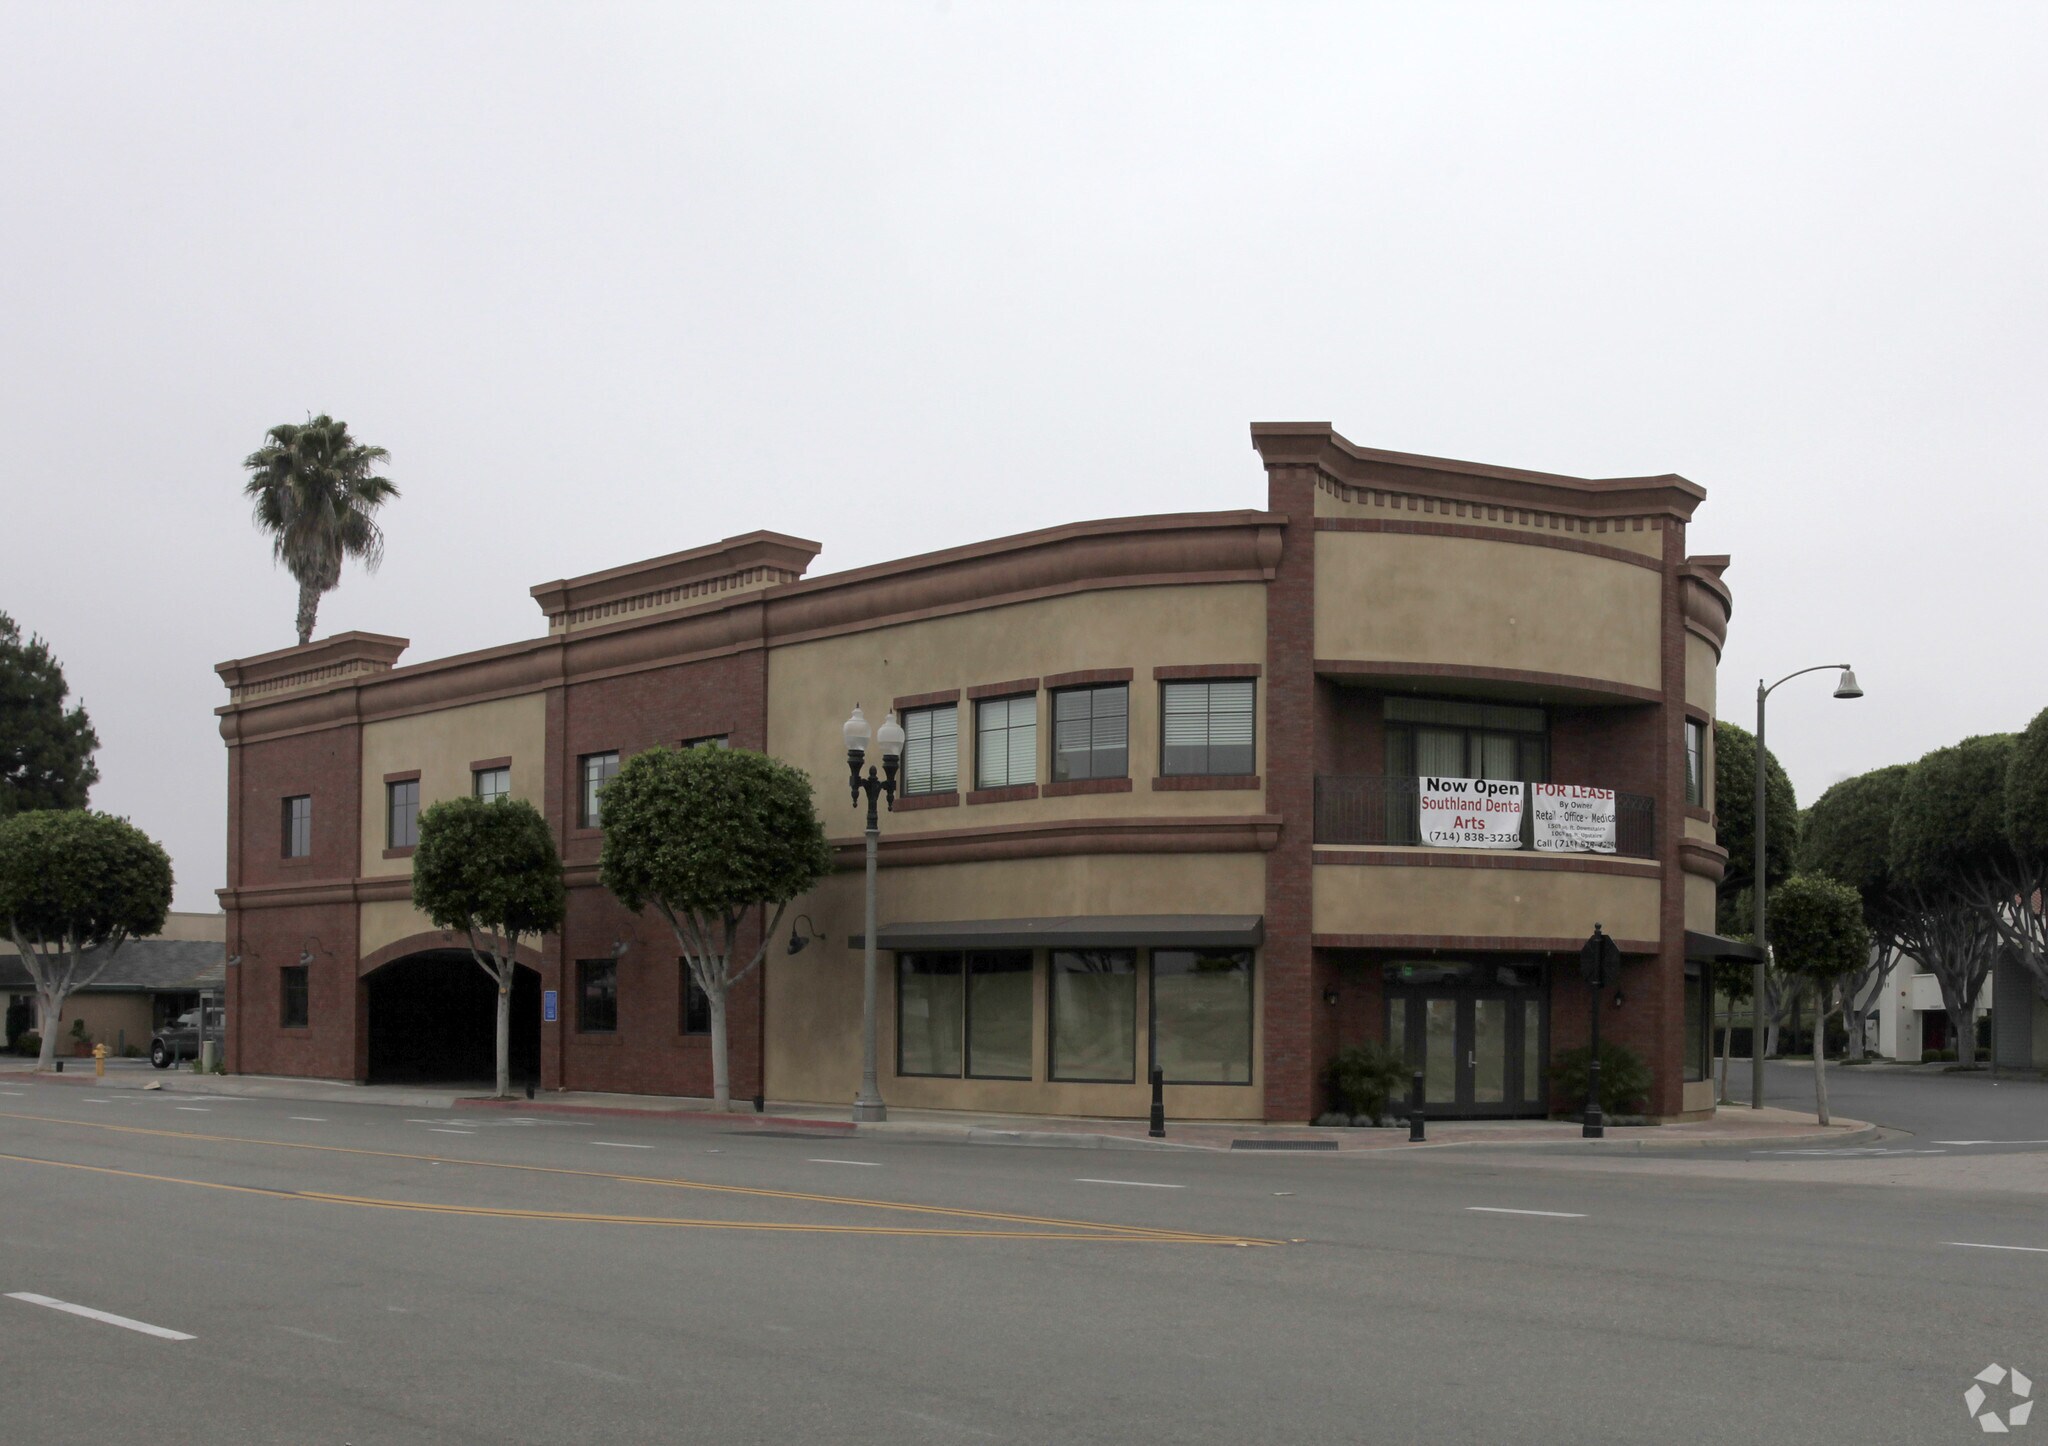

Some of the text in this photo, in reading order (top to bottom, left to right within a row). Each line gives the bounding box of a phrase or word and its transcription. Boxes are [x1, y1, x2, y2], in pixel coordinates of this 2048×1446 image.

[1427, 778, 1519, 797] Now Open
[1536, 783, 1613, 799] FOR LEASE
[1422, 796, 1481, 811] Southland
[1560, 801, 1592, 809] By Owner
[1454, 815, 1485, 830] Arts
[1536, 810, 1556, 820] Retail
[1429, 831, 1518, 843] (714) 838-3230
